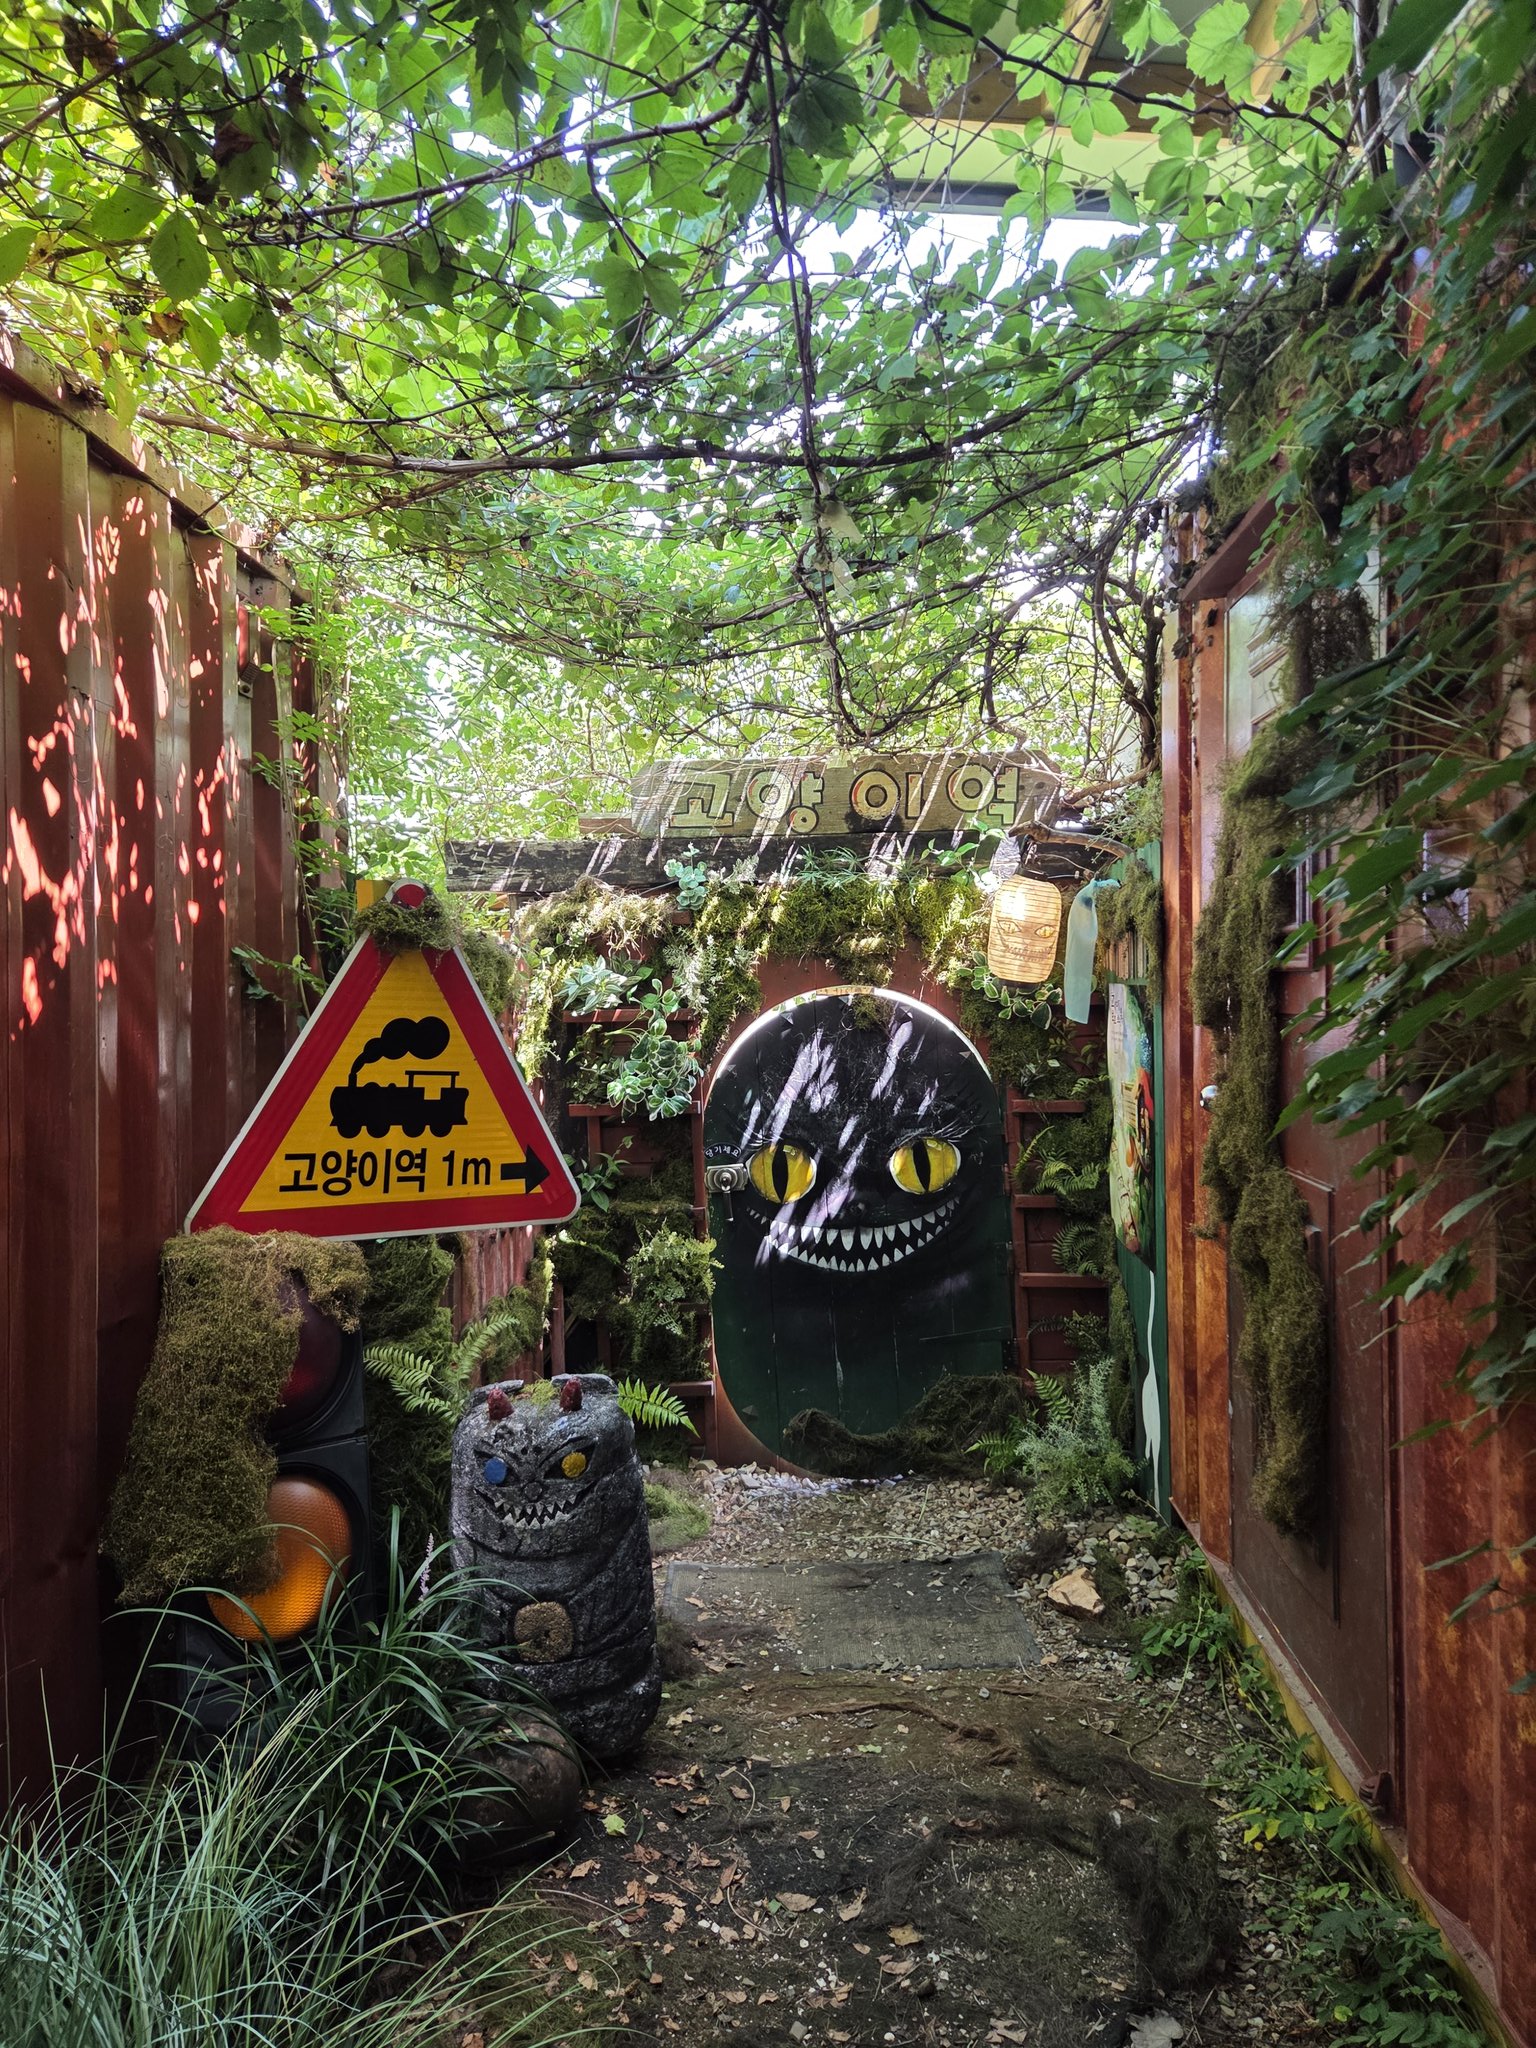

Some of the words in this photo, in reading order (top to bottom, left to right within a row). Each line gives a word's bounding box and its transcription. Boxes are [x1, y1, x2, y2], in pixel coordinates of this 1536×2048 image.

[667, 763, 1019, 833] 고양이역
[279, 1147, 428, 1197] 고양이역
[442, 1150, 491, 1187] 1m
[705, 1145, 739, 1158] 당기세요
